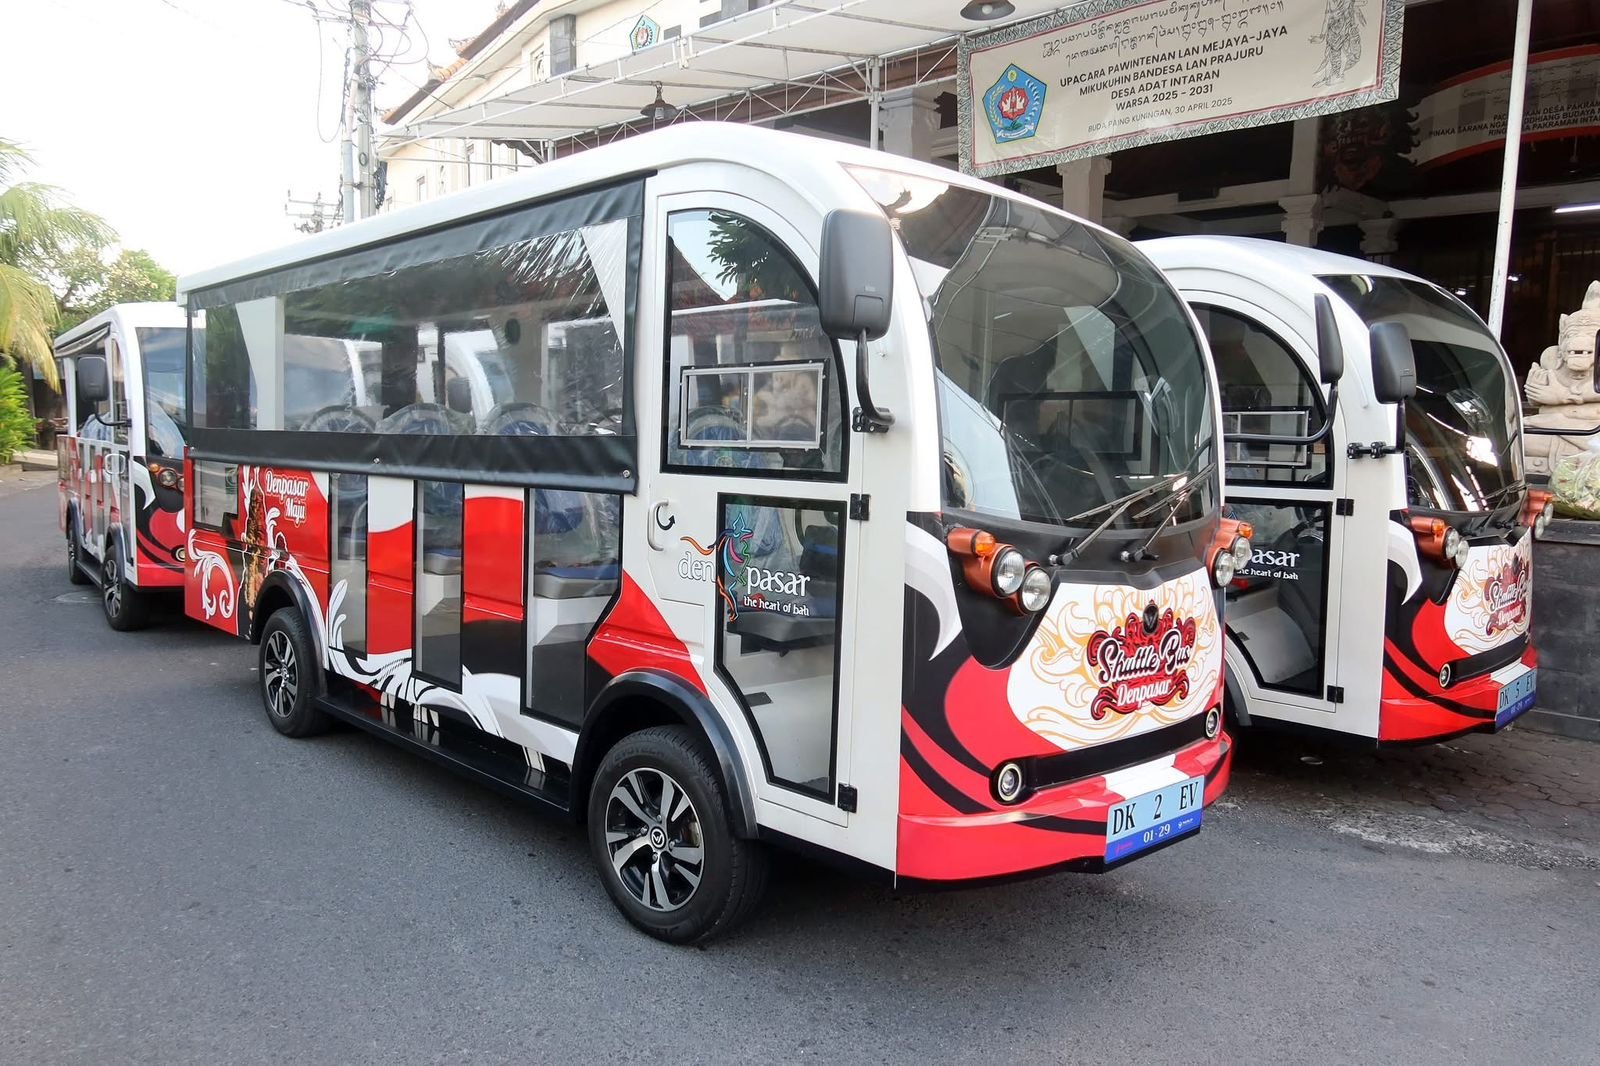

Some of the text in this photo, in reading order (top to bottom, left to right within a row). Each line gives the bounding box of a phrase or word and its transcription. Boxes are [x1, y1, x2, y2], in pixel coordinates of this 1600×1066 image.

[1060, 25, 1288, 87] UPACARA PAWINTENAN LAN MEJAYA-JAYA
[1079, 45, 1264, 96] MIKUKUHIN BANDESA LAN PRAJURU
[1111, 69, 1220, 100] DESA ADAT INTARAN
[1115, 96, 1150, 111] WARSA
[1152, 90, 1178, 103] 2025
[1189, 83, 1213, 96] 2031
[1543, 104, 1565, 114] DESA
[1088, 122, 1107, 133] BUDA
[1108, 116, 1131, 127] PAING
[1174, 105, 1186, 114] 30
[1187, 101, 1209, 112] APRIL
[1211, 97, 1233, 108] 2025
[1532, 117, 1578, 130] PAKRAMAN
[1562, 107, 1596, 119] BUDAYA
[266, 470, 309, 501] Denpasar
[285, 498, 306, 524] Maju
[1249, 548, 1301, 567] asar
[1250, 567, 1271, 577] heart
[1273, 570, 1282, 578] of
[743, 596, 758, 607] the
[759, 598, 781, 612] heart
[783, 603, 792, 613] of
[1097, 637, 1160, 685] Shuttle
[1117, 679, 1172, 708] Denpasar
[1499, 687, 1510, 709] DK
[1112, 781, 1198, 836] DK 2 EV
